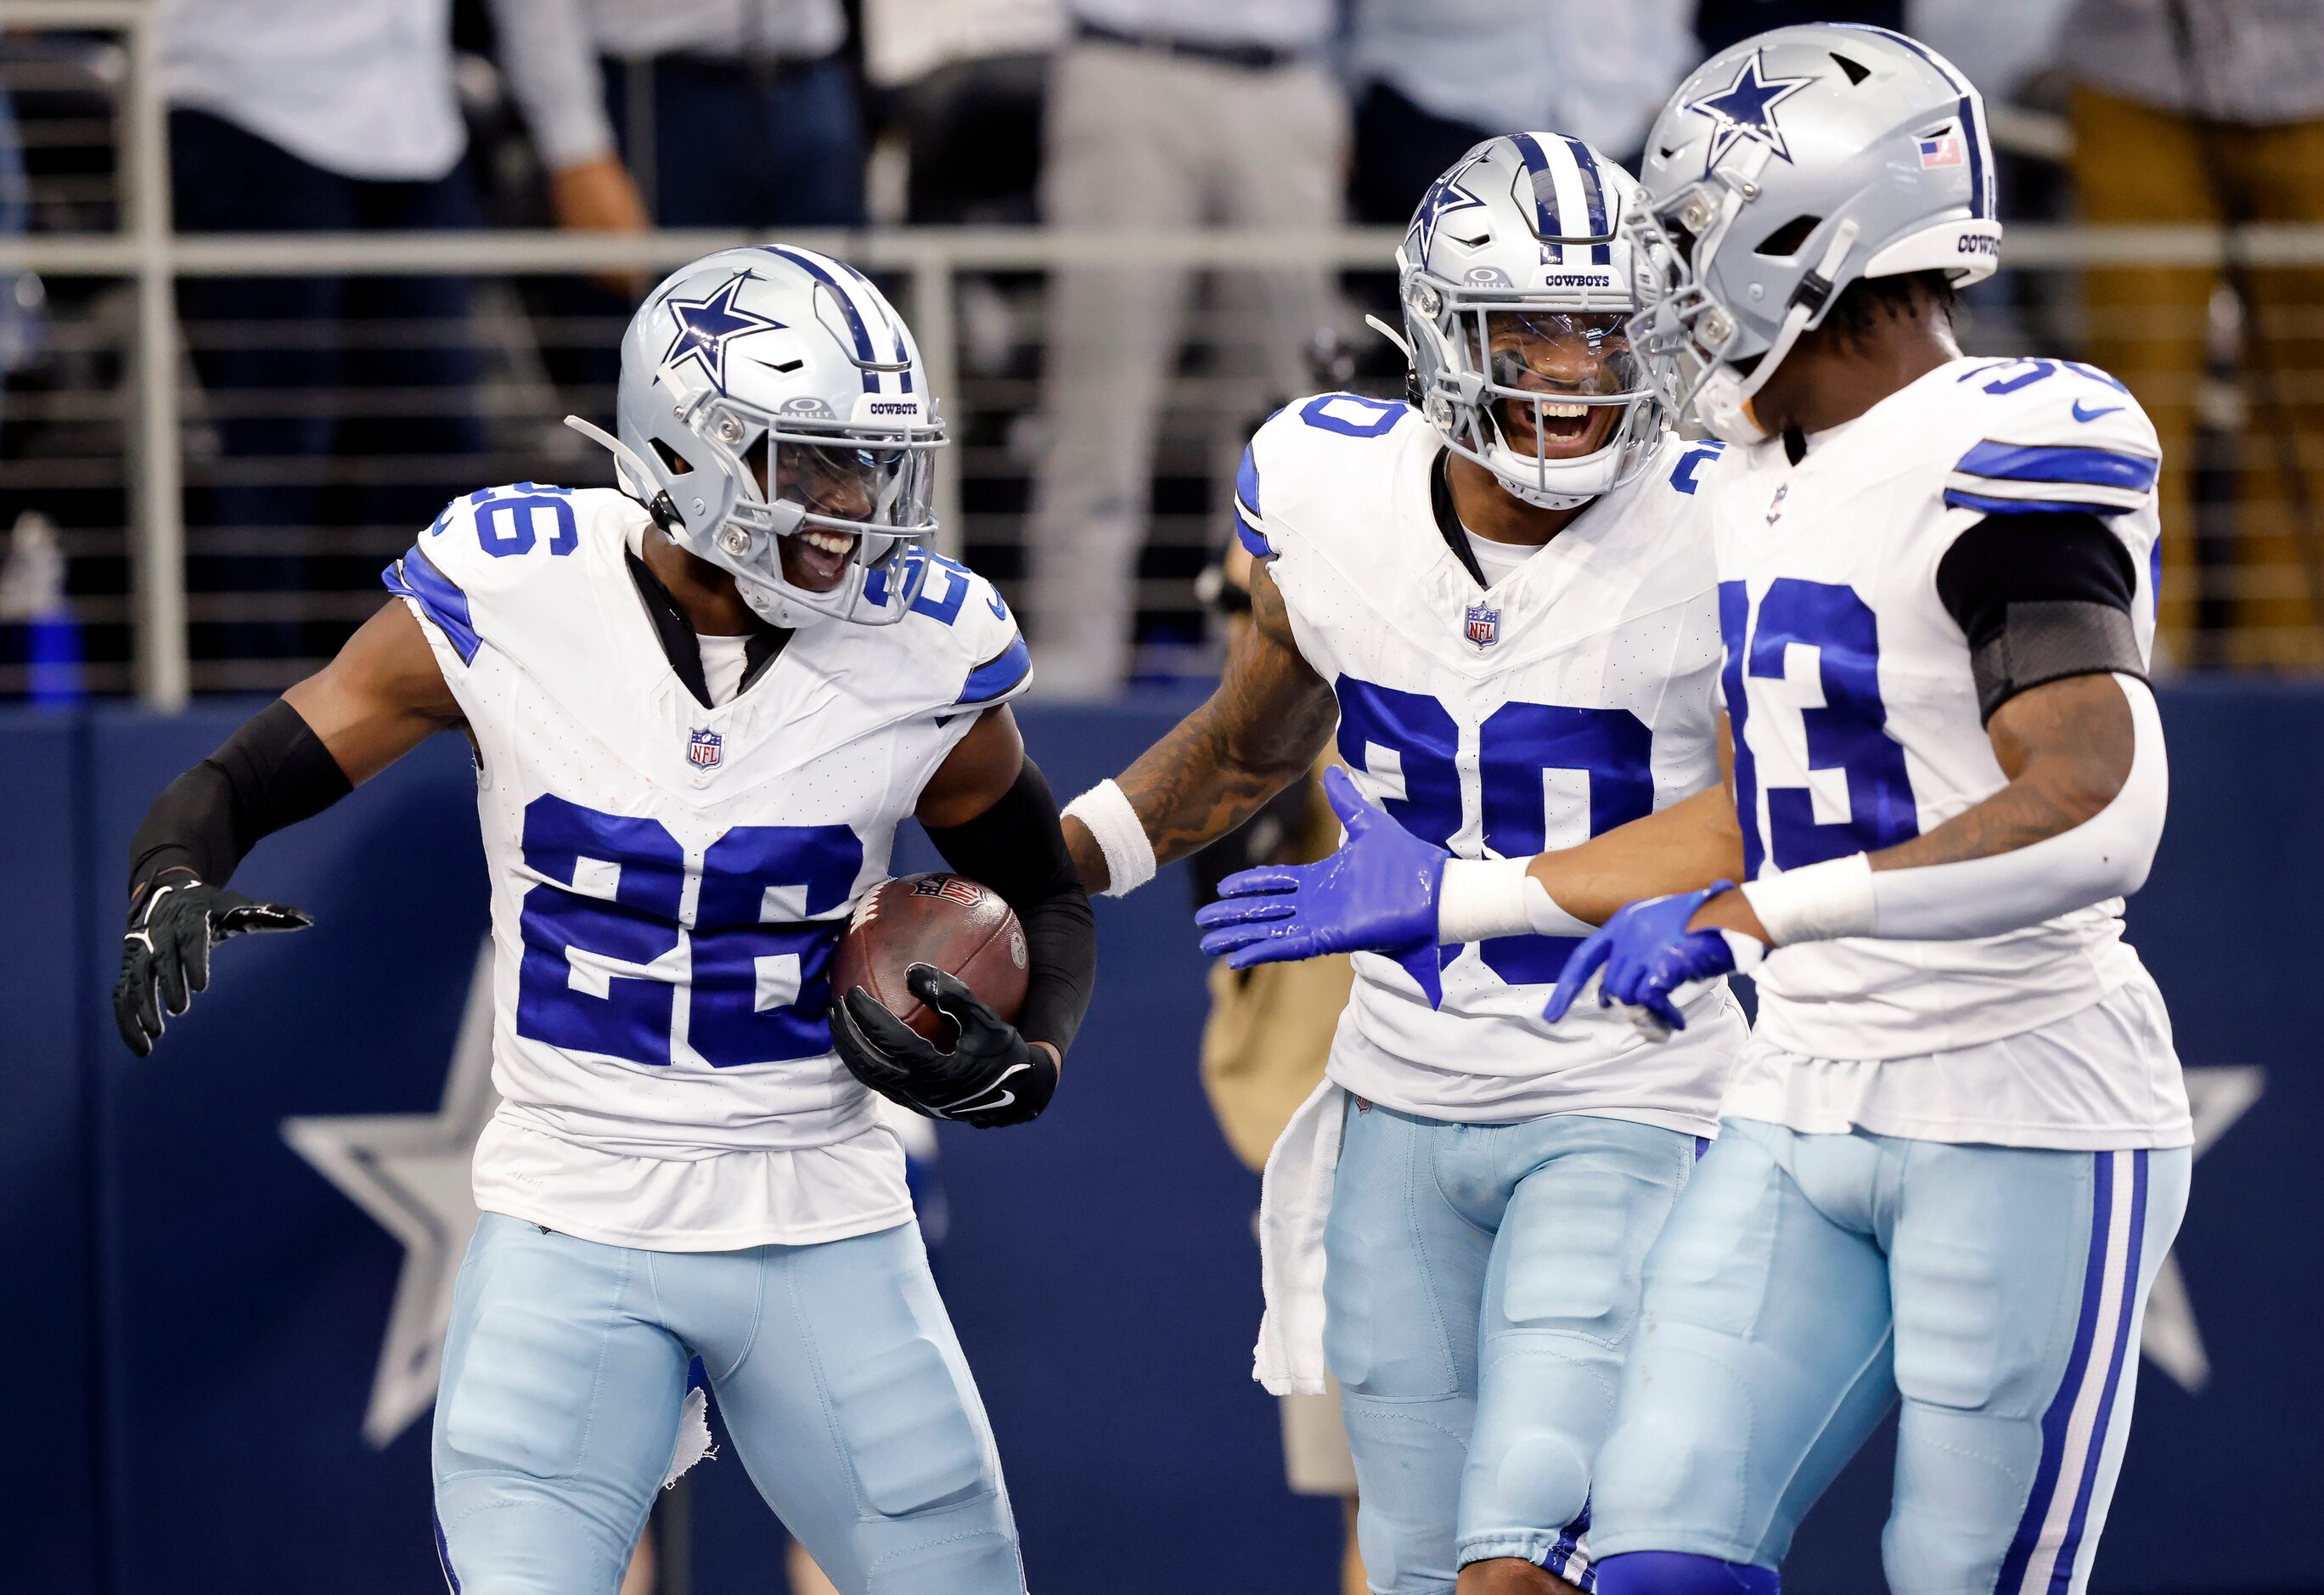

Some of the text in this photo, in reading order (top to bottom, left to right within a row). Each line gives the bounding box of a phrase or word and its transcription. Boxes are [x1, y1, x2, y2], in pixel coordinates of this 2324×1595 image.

[1545, 275, 1610, 287] COWBOYS
[870, 403, 918, 415] COWBOYS
[1298, 393, 1410, 438] 0
[470, 481, 579, 558] 6
[1469, 622, 1493, 640] NFL
[692, 745, 717, 764] NFL
[941, 881, 979, 903] NFL
[516, 792, 864, 1068] 26
